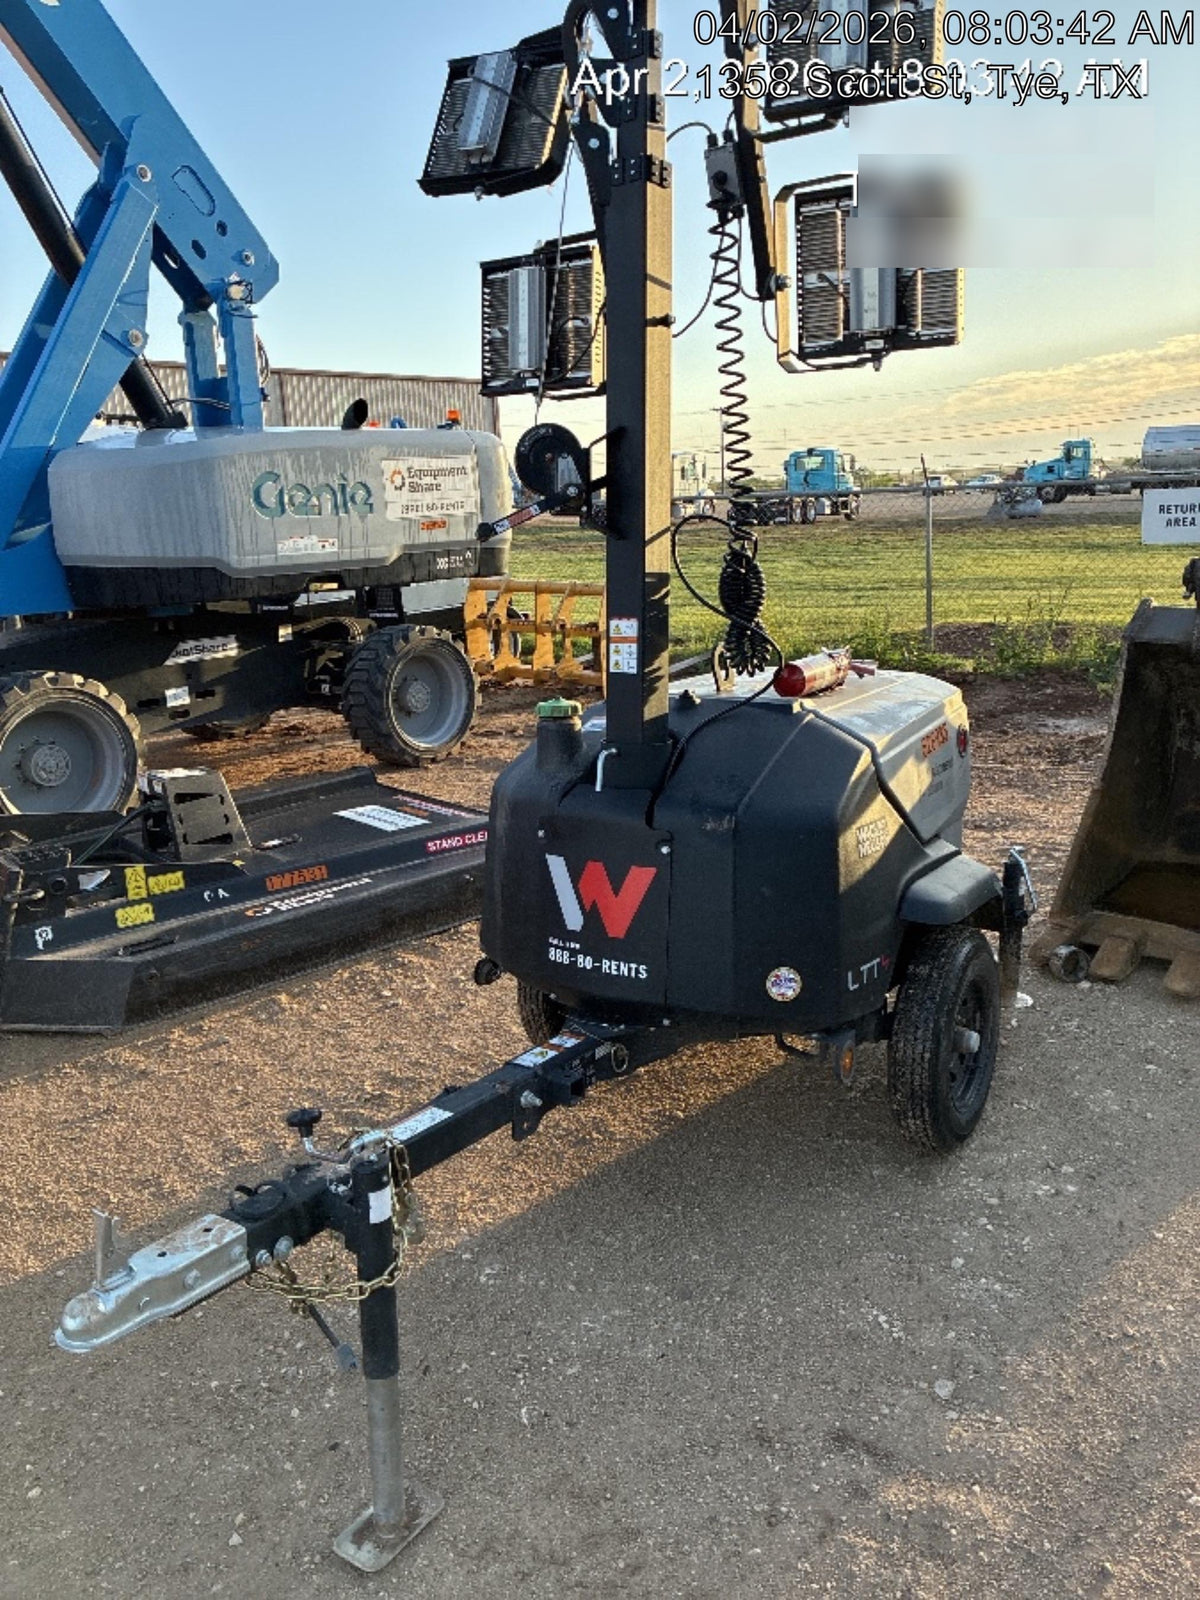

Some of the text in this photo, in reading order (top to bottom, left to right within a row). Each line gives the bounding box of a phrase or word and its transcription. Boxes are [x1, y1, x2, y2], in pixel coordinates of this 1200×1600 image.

[407, 465, 468, 481] Equipment
[408, 480, 443, 493] Share
[250, 470, 374, 519] Genie
[1158, 503, 1200, 515] RETUR
[1165, 516, 1197, 528] AREA
[428, 835, 464, 853] STAND
[464, 830, 488, 844] CLE
[548, 946, 649, 980] 888-80-RENTS
